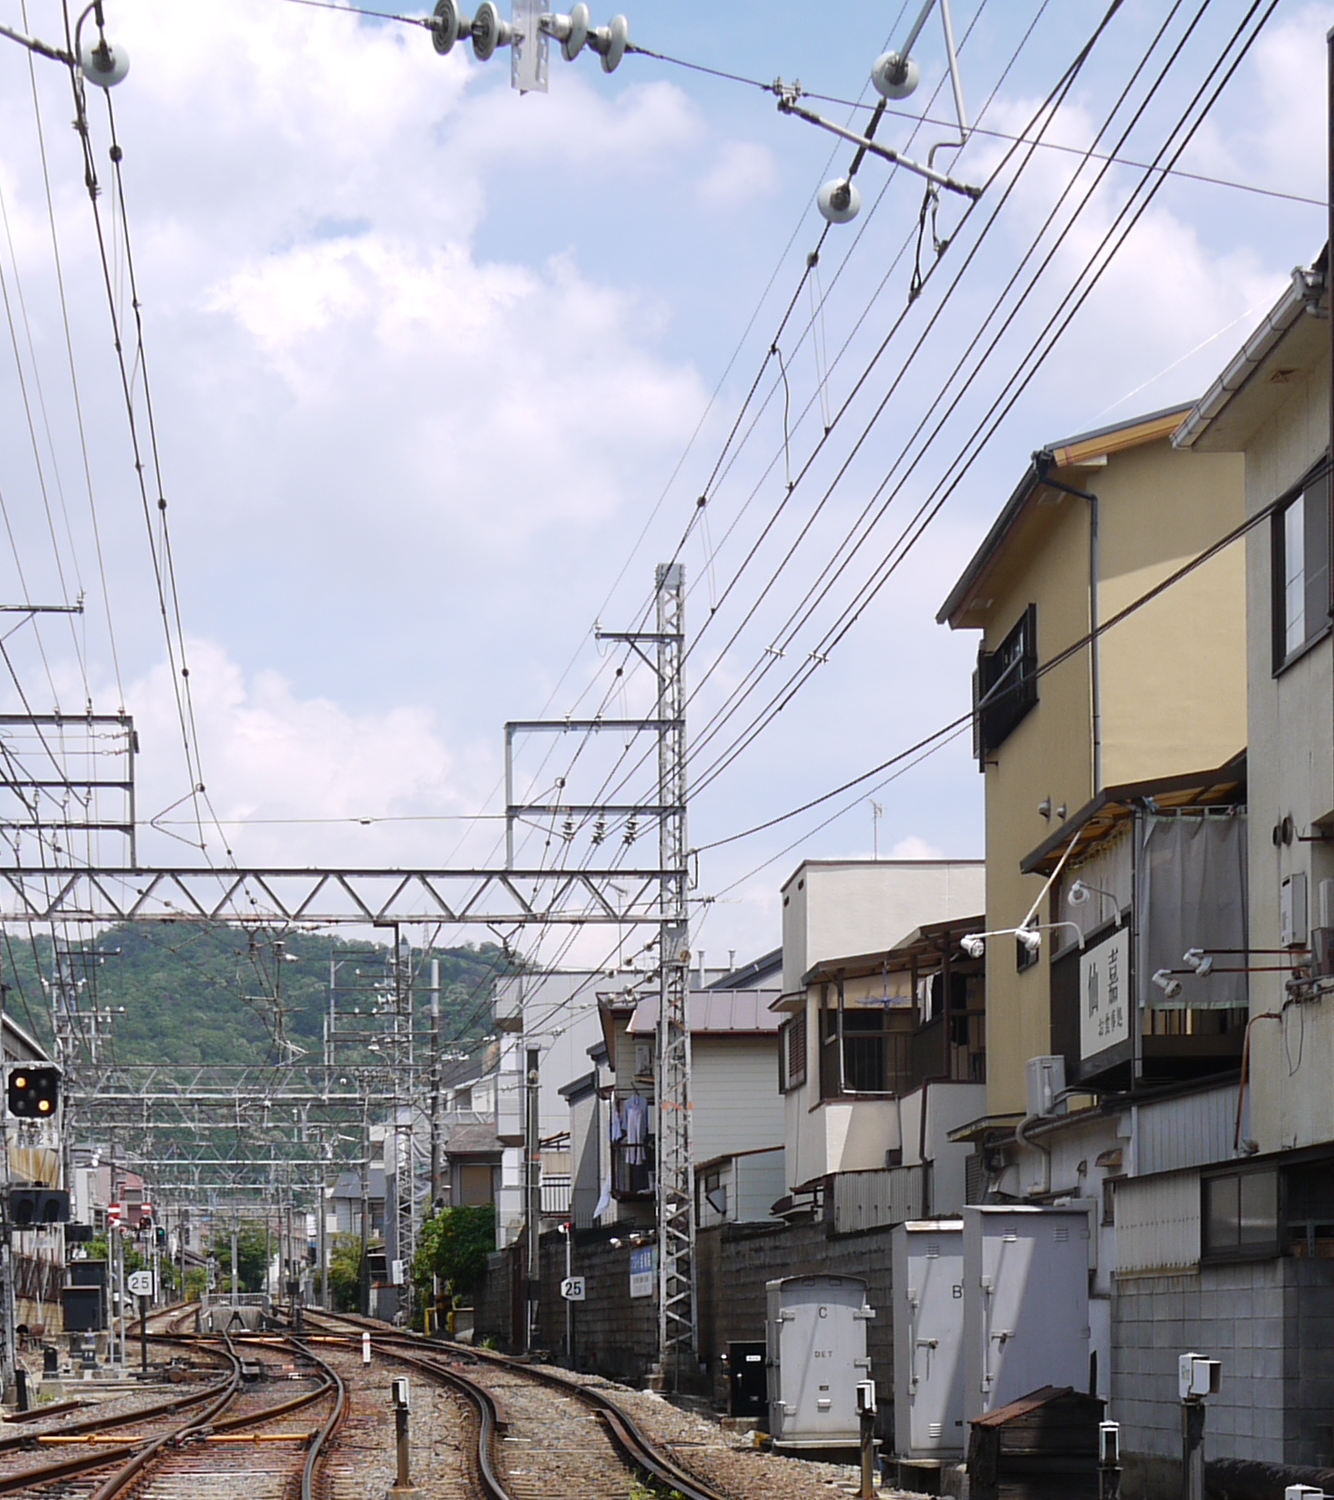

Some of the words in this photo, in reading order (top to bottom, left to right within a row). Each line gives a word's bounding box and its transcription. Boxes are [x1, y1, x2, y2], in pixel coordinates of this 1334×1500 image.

[131, 1277, 150, 1289] 25
[564, 1280, 582, 1297] 25
[951, 1285, 962, 1299] B
[817, 1307, 827, 1319] C
